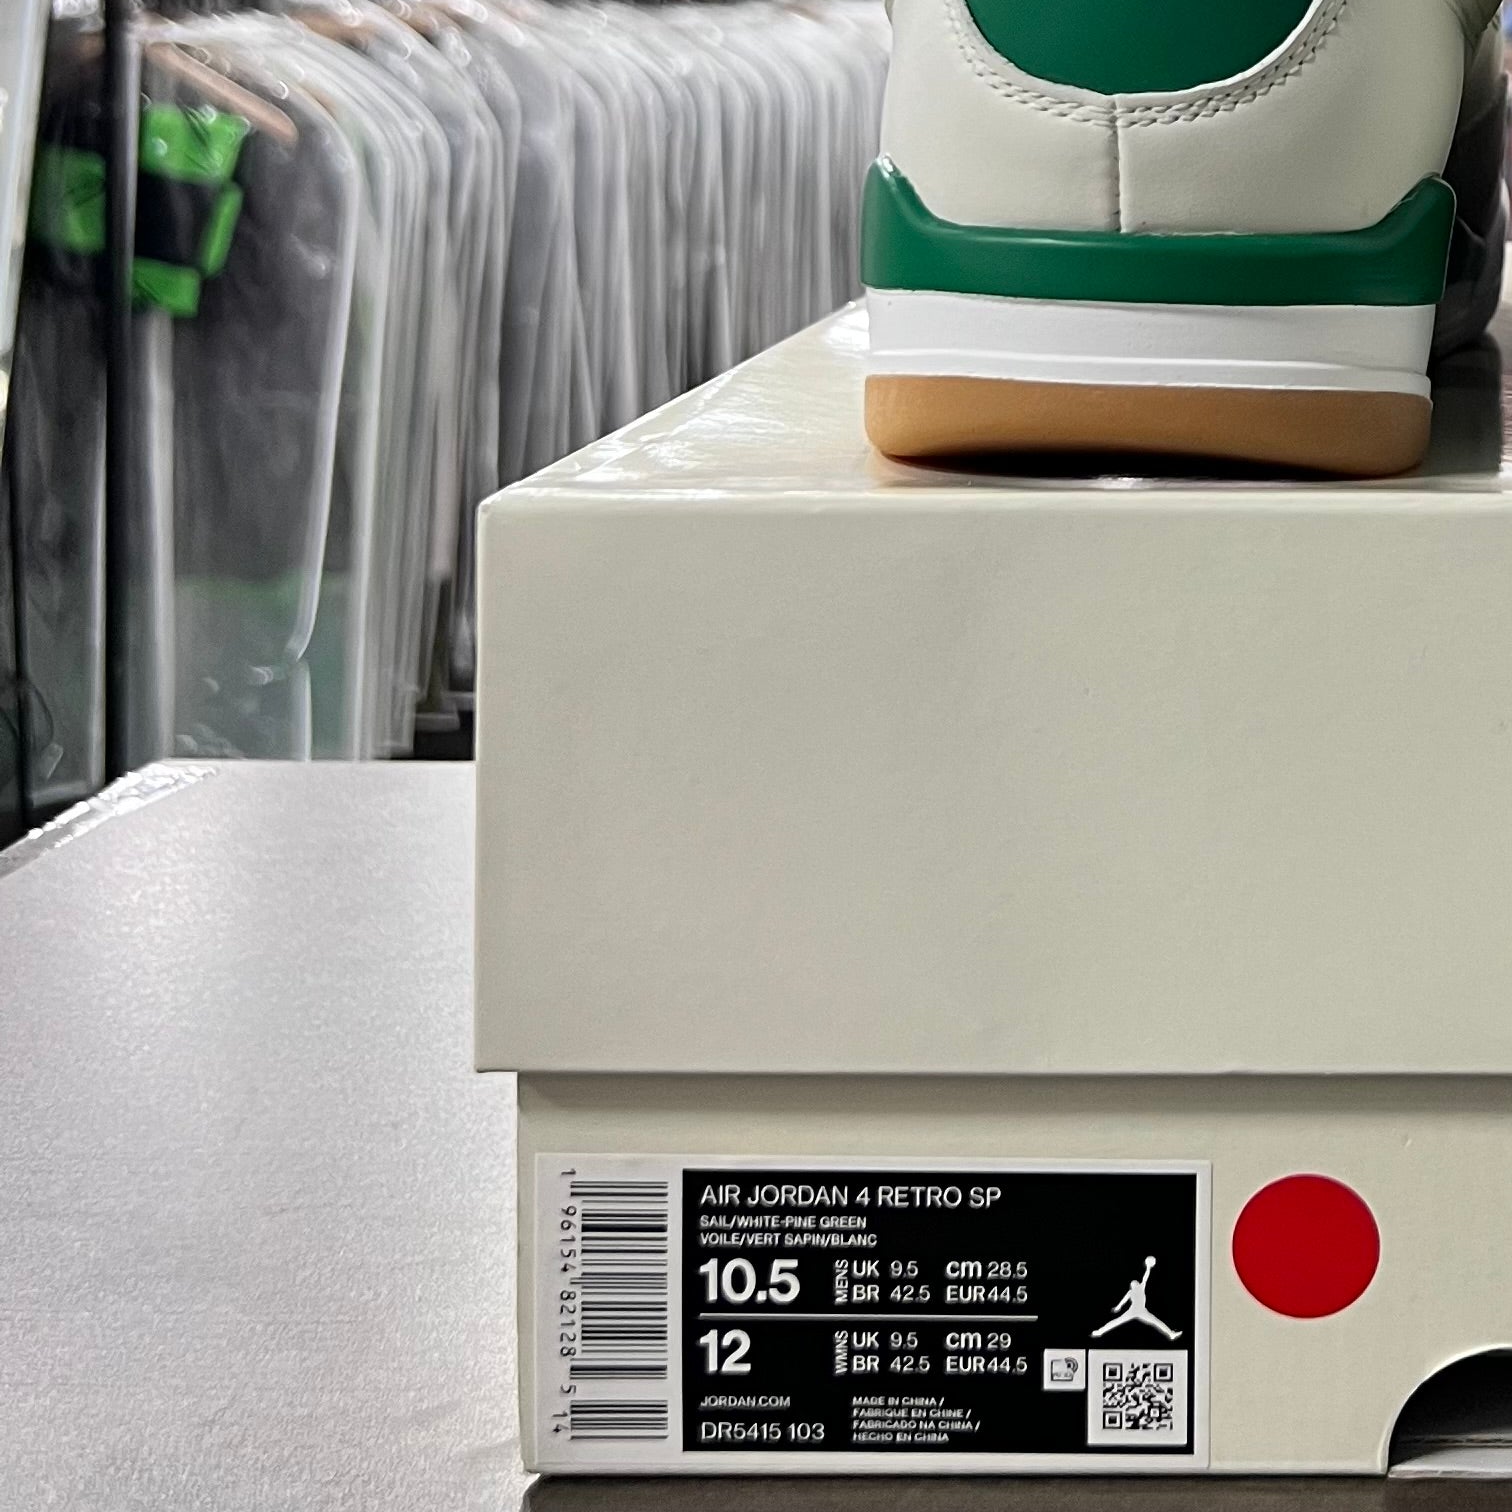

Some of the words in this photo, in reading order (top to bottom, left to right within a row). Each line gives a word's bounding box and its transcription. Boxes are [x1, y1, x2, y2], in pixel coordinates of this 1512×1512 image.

[700, 1184, 741, 1207] AIR
[747, 1185, 848, 1208] JORDAN
[855, 1186, 871, 1208] 4
[877, 1186, 962, 1209] RETRO
[969, 1186, 1002, 1209] SP
[700, 1215, 817, 1230] SAIL/WHITE-PINE
[820, 1216, 867, 1230] GREEN
[560, 1205, 577, 1274] 96154
[700, 1232, 781, 1247] VOILE/VERT
[784, 1233, 878, 1248] SAPIN/BLANC
[852, 1260, 880, 1279] UK
[890, 1260, 919, 1279] 9.5
[945, 1261, 982, 1279] cm
[987, 1261, 1028, 1280] 28.5
[699, 1258, 800, 1304] 10.5
[834, 1259, 849, 1305] MENS
[852, 1284, 880, 1303] BR
[890, 1285, 931, 1303] 42.5
[560, 1290, 577, 1358] 82128
[852, 1331, 880, 1350] UK
[890, 1331, 918, 1350] 9.5
[945, 1332, 982, 1351] cm
[987, 1332, 1012, 1351] 29
[699, 1329, 752, 1375] 12
[834, 1330, 848, 1376] WMNS
[852, 1355, 880, 1374] BR
[890, 1355, 931, 1375] 42.5
[700, 1395, 791, 1410] JORDAN.COM
[852, 1396, 886, 1407] MADE
[887, 1396, 900, 1407] IN
[901, 1396, 937, 1408] CHINA
[852, 1408, 909, 1419] FABRIQUE
[911, 1408, 927, 1419] EN
[929, 1408, 964, 1419] CHINE
[700, 1420, 782, 1443] DR5415
[788, 1421, 825, 1443] 103
[852, 1420, 917, 1431] FABRICADO
[919, 1420, 936, 1431] NA
[938, 1420, 974, 1431] CHINA
[852, 1432, 894, 1443] HECHO
[895, 1432, 912, 1443] EN
[914, 1432, 949, 1443] CHINA
